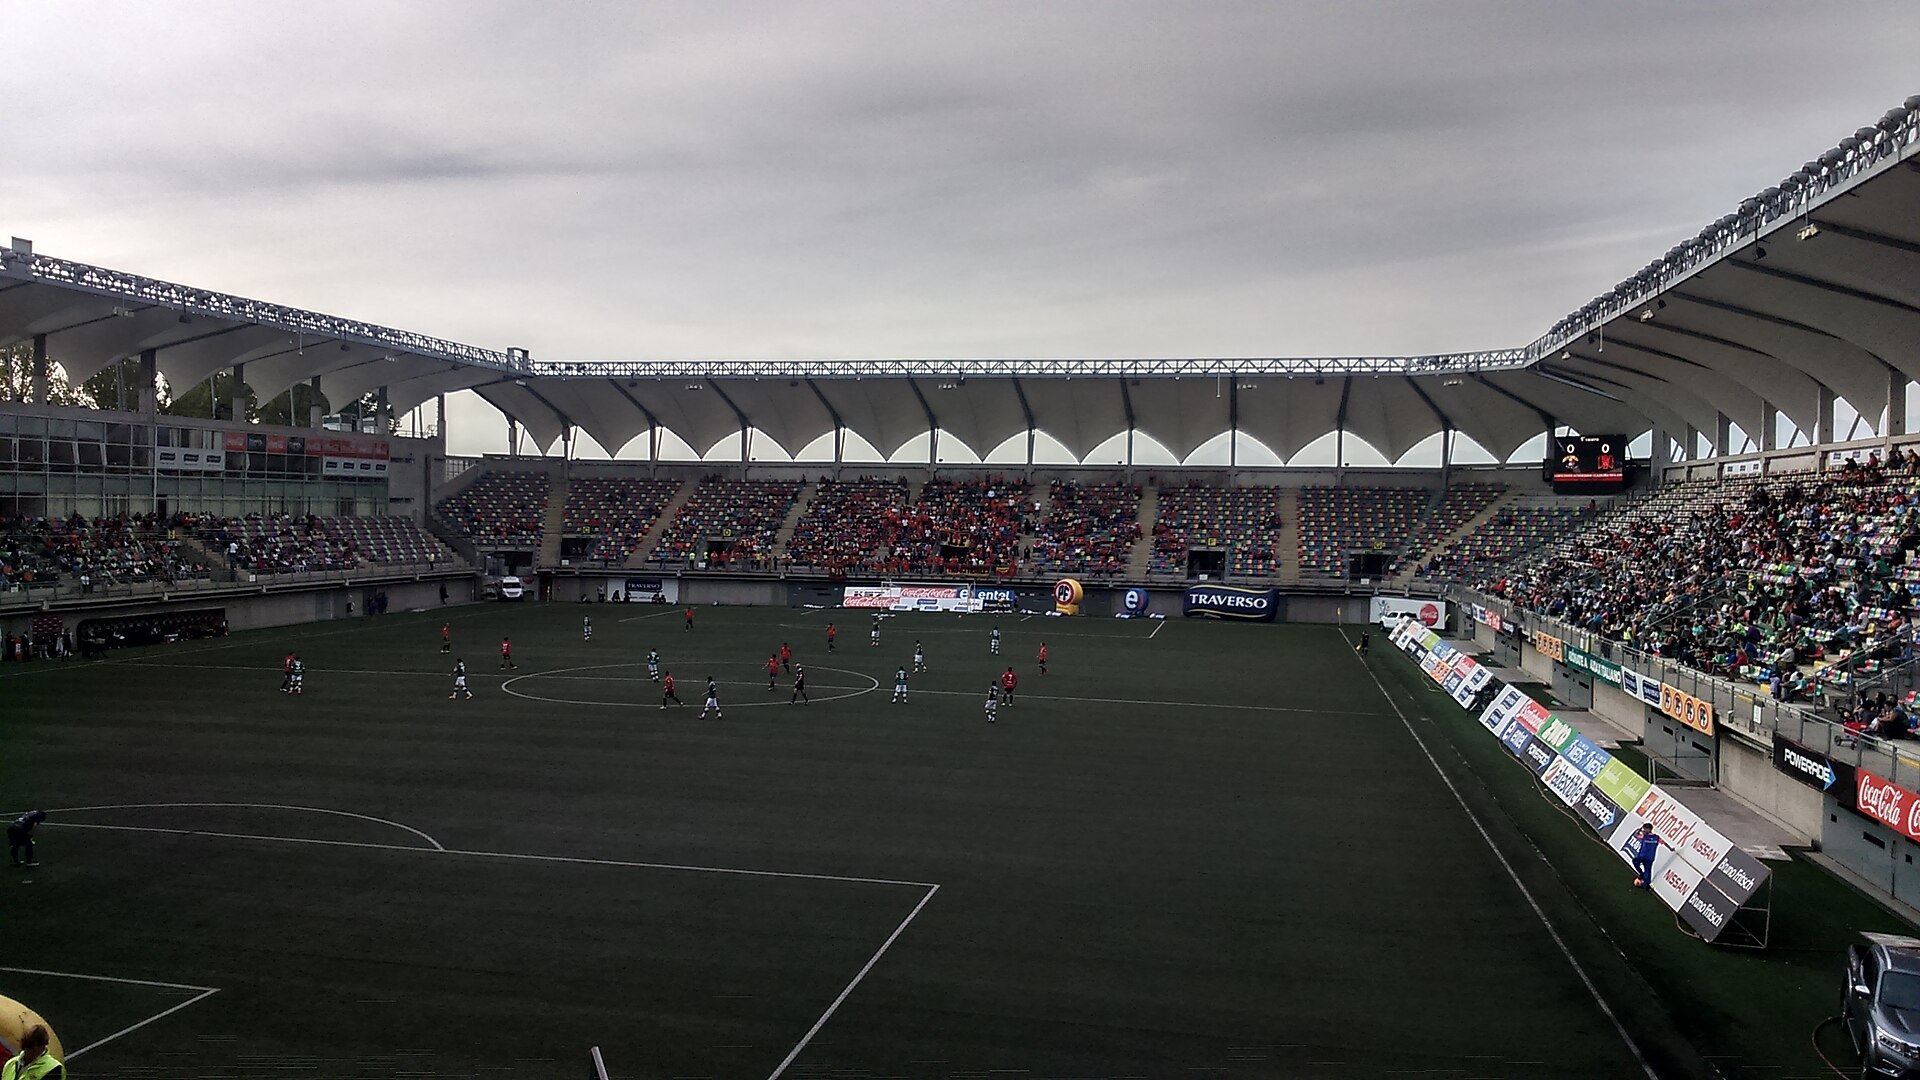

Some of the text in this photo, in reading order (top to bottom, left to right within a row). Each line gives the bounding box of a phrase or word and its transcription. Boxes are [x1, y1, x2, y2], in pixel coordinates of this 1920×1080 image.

[1566, 444, 1575, 454] 0
[1601, 444, 1610, 454] 0
[978, 590, 1010, 600] entel
[1189, 594, 1268, 609] TRAVERSO
[1784, 748, 1830, 783] POWERADE
[1582, 792, 1613, 824] POWERADE
[1859, 775, 1903, 826] Coca-Cola
[1646, 799, 1697, 848] Adimark
[1690, 838, 1719, 863] NISSAN
[1663, 869, 1690, 896] NISSAN
[1717, 858, 1755, 892] Bruno Fritsch
[1688, 892, 1723, 928] Bruno Fritsch
